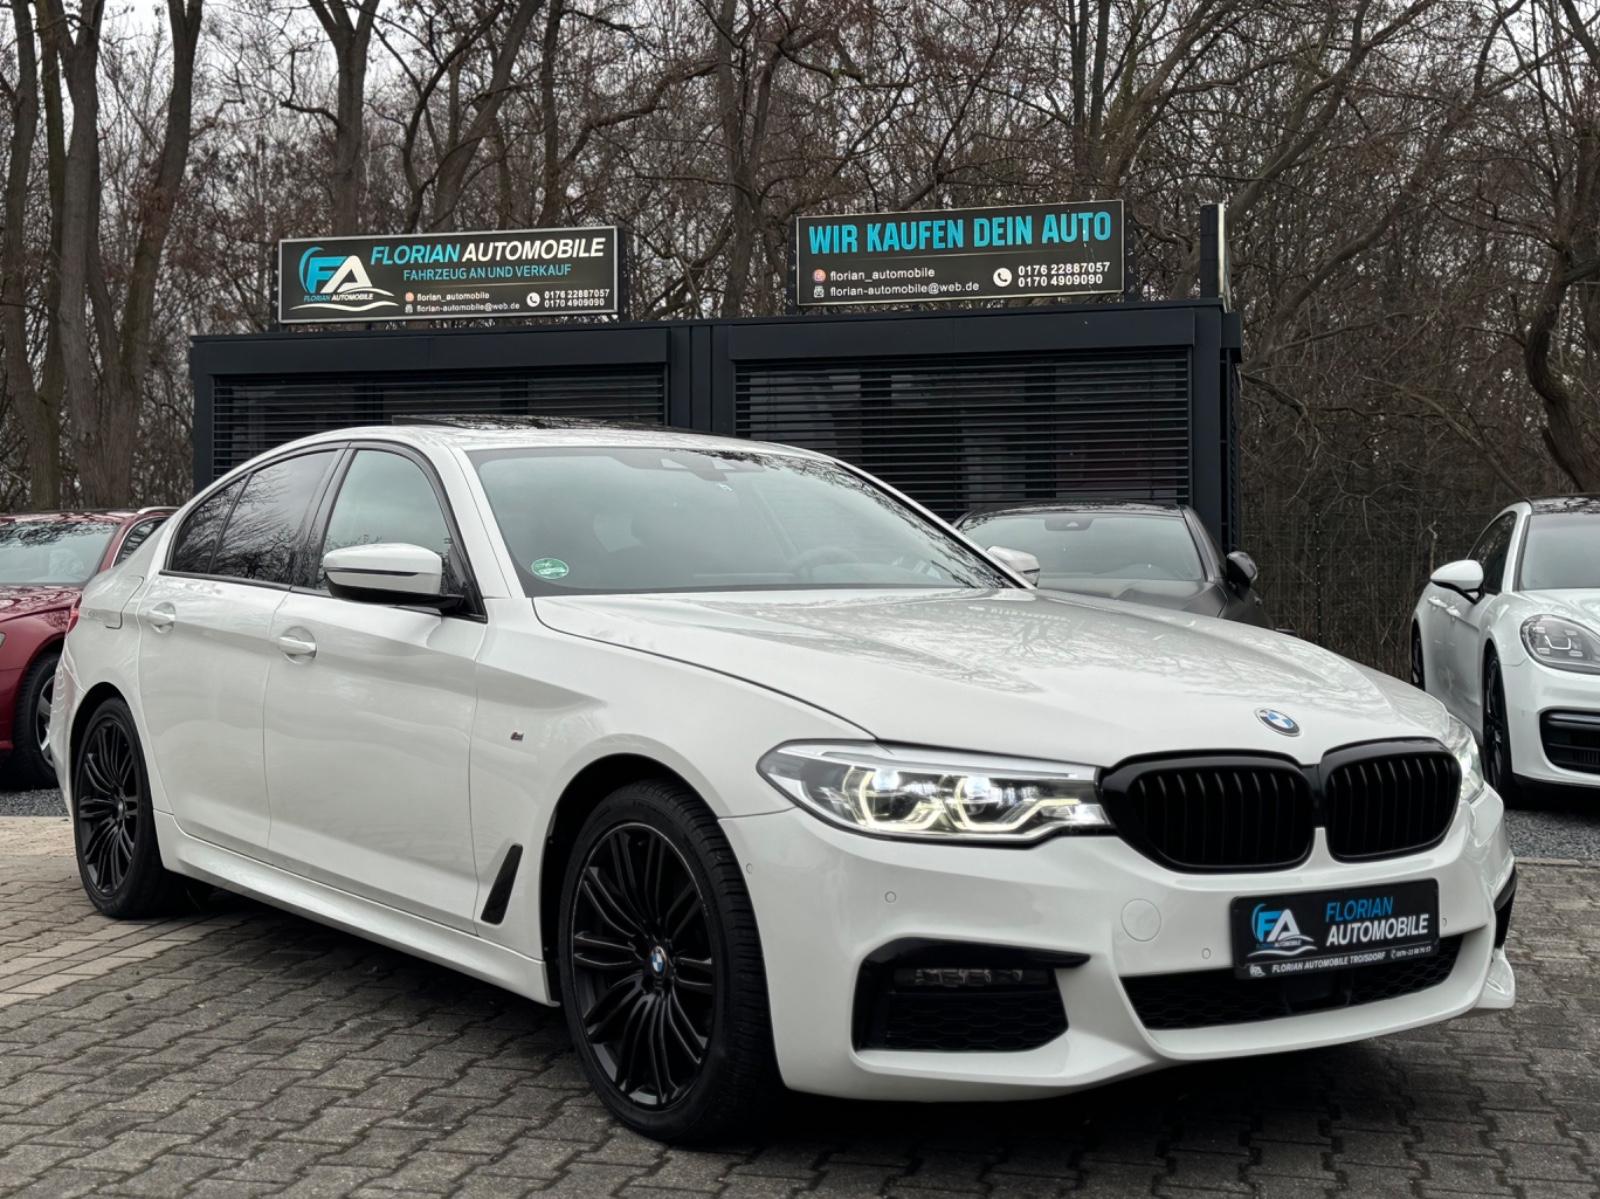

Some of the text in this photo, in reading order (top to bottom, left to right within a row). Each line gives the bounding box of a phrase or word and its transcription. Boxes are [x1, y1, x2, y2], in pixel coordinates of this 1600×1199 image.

[808, 211, 1112, 254] WIR KAUFEN DEIN AUTO
[370, 237, 606, 265] FLORIAN AUTOMOBILE
[403, 263, 572, 281] FAHRZEUG AN UND VERKAUF
[830, 267, 935, 282] florian_automobile
[1018, 262, 1111, 276] 0176 22887057
[830, 281, 980, 297] florian-automobile@web.de
[1018, 274, 1103, 288] 0170 4909090
[331, 293, 374, 302] AUTOMOBILE
[1325, 896, 1393, 923] FLORIAN
[1326, 913, 1430, 947] AUTOMOBILE
[1271, 961, 1303, 974] FLORIAN
[1304, 956, 1348, 970] AUTOMOBILE
[1350, 951, 1385, 965] TROISDORF
